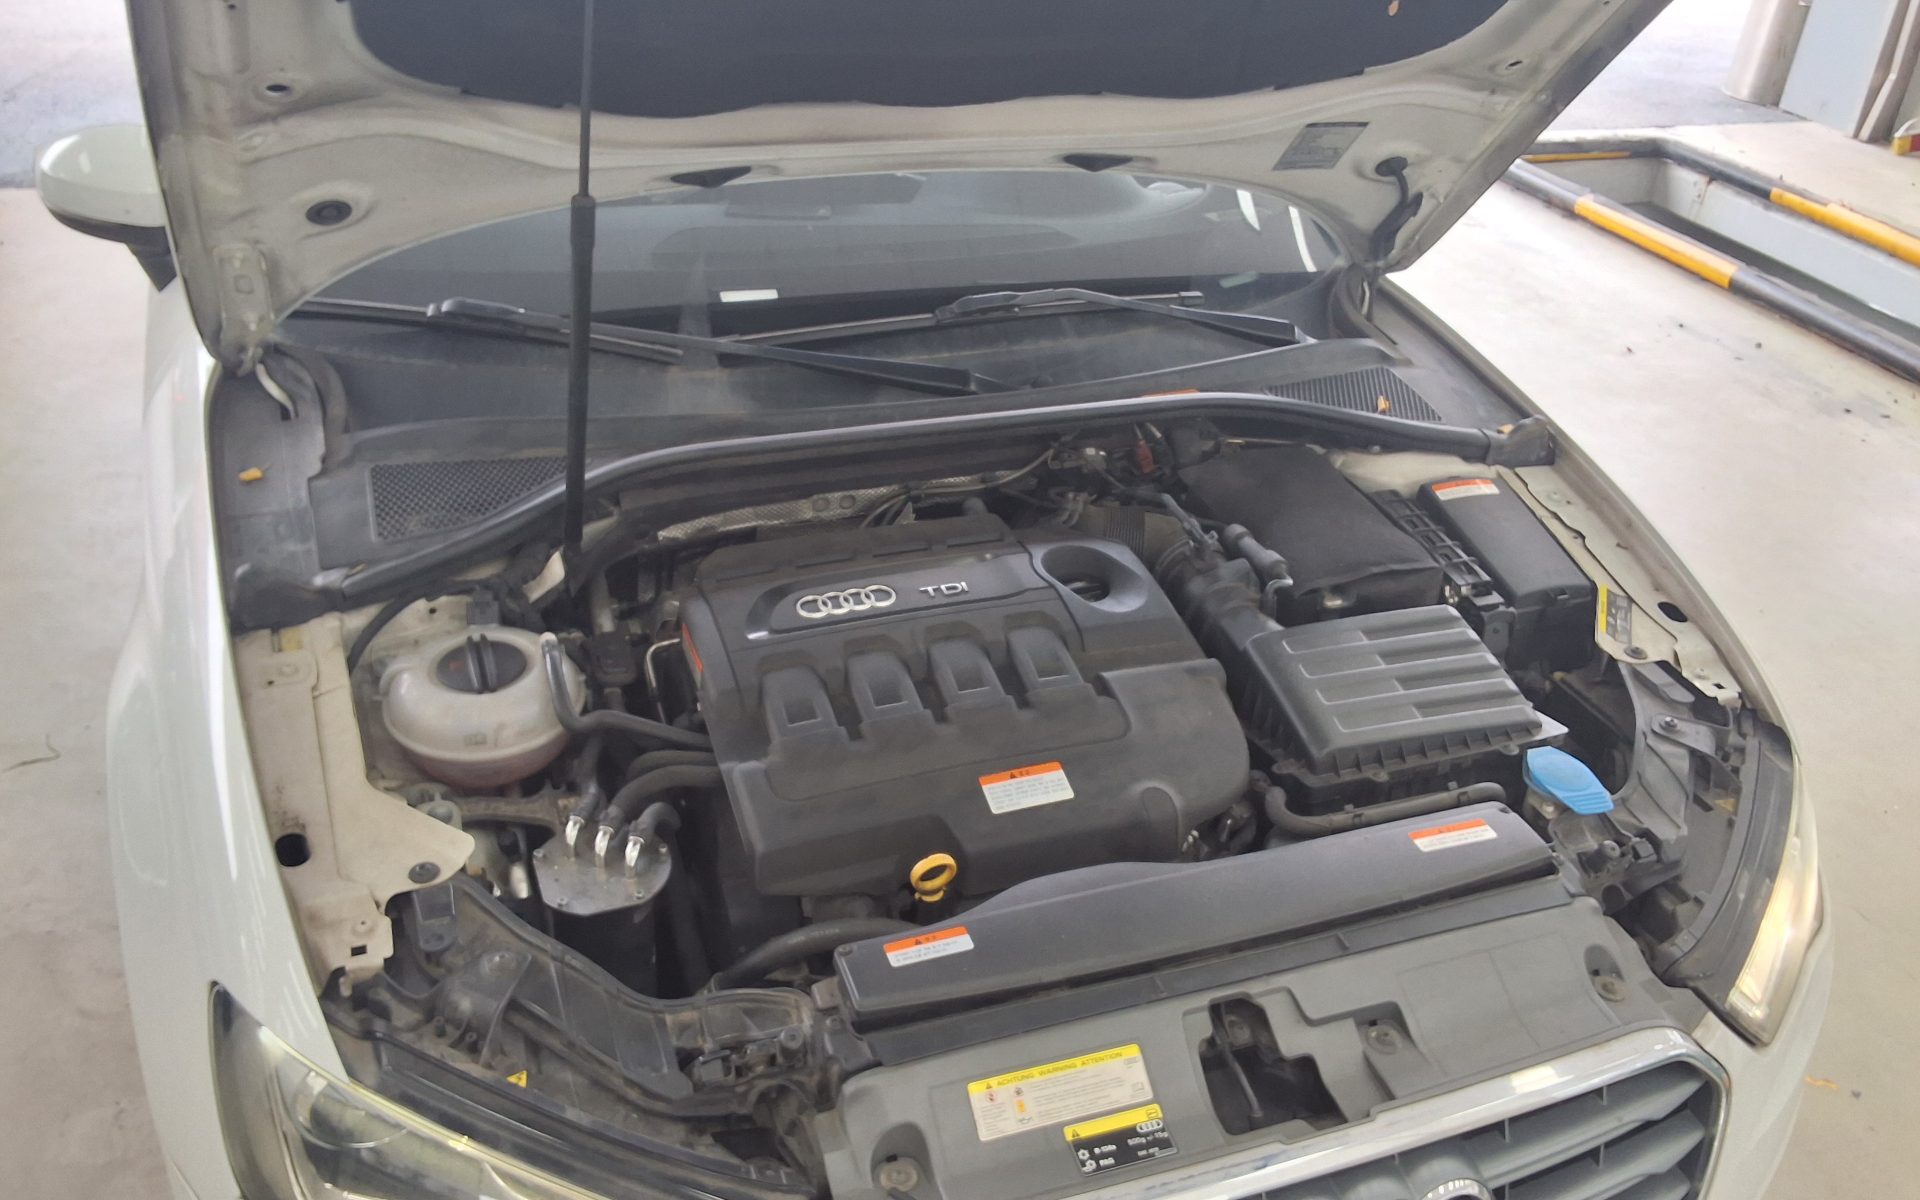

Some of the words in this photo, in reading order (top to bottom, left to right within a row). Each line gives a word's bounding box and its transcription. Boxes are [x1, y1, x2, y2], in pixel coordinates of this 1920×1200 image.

[919, 581, 969, 597] TDI
[997, 1072, 1035, 1087] ACHTUNG
[1038, 1061, 1078, 1077] WARNING
[1081, 1051, 1123, 1067] ATTENTION
